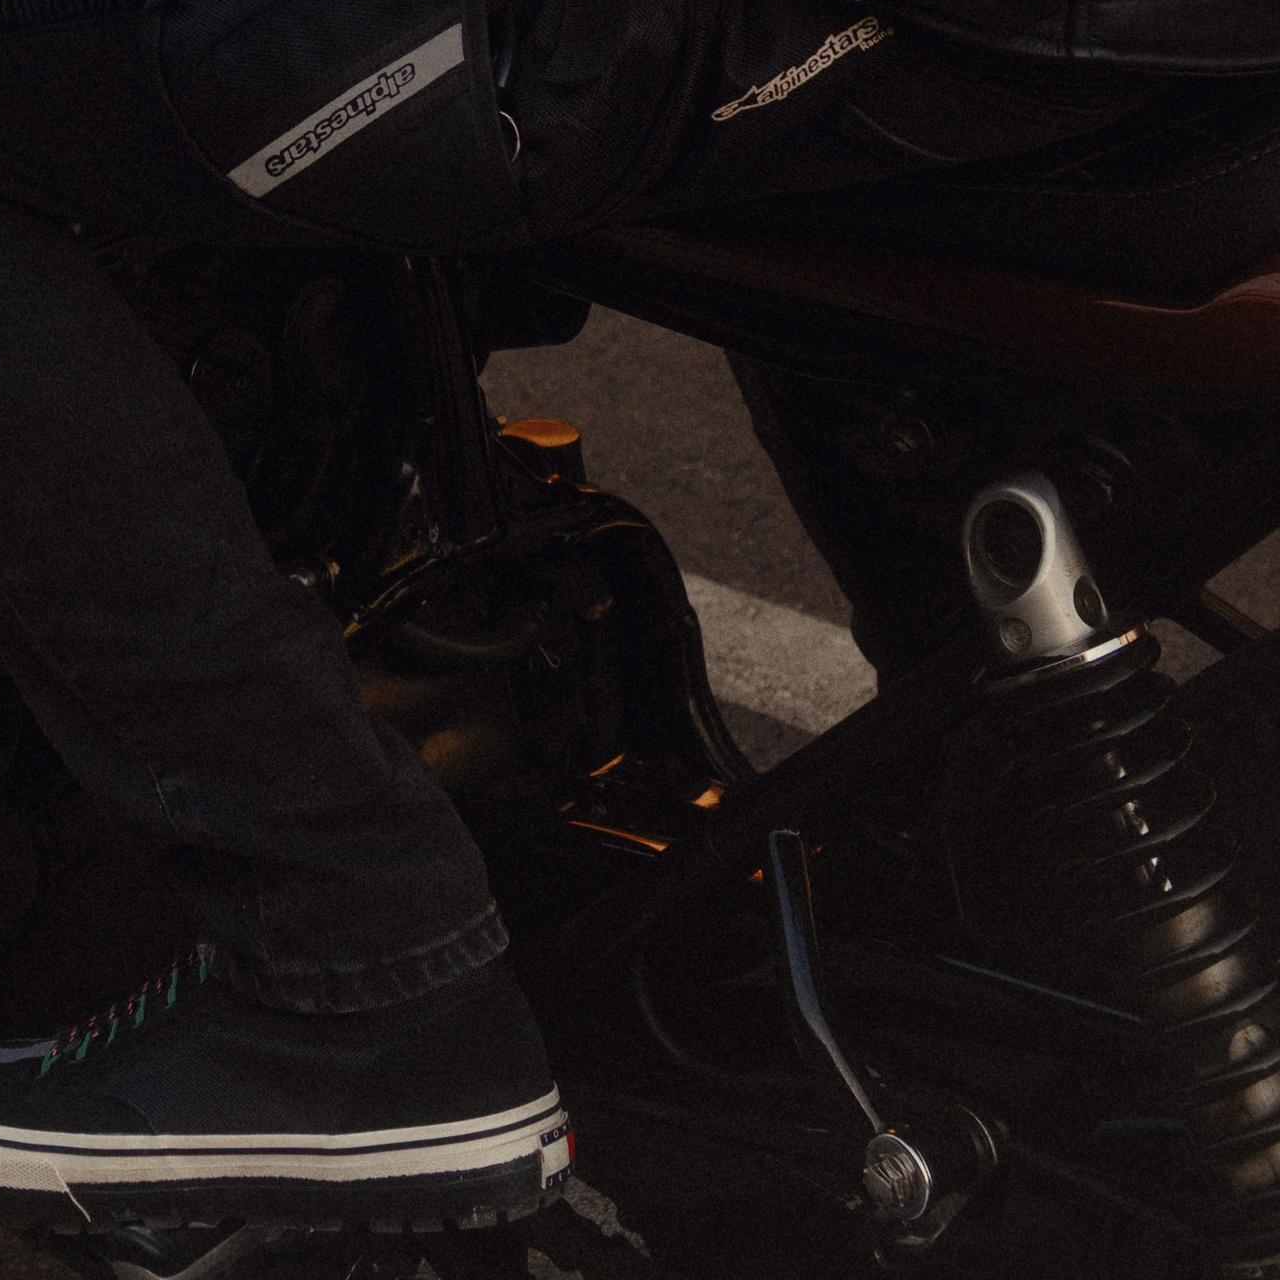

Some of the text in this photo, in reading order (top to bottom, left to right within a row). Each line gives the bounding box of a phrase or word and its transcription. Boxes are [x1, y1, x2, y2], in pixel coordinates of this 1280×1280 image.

[757, 17, 880, 102] alpinestars
[858, 27, 895, 52] Racing
[264, 61, 417, 178] alpinestars
